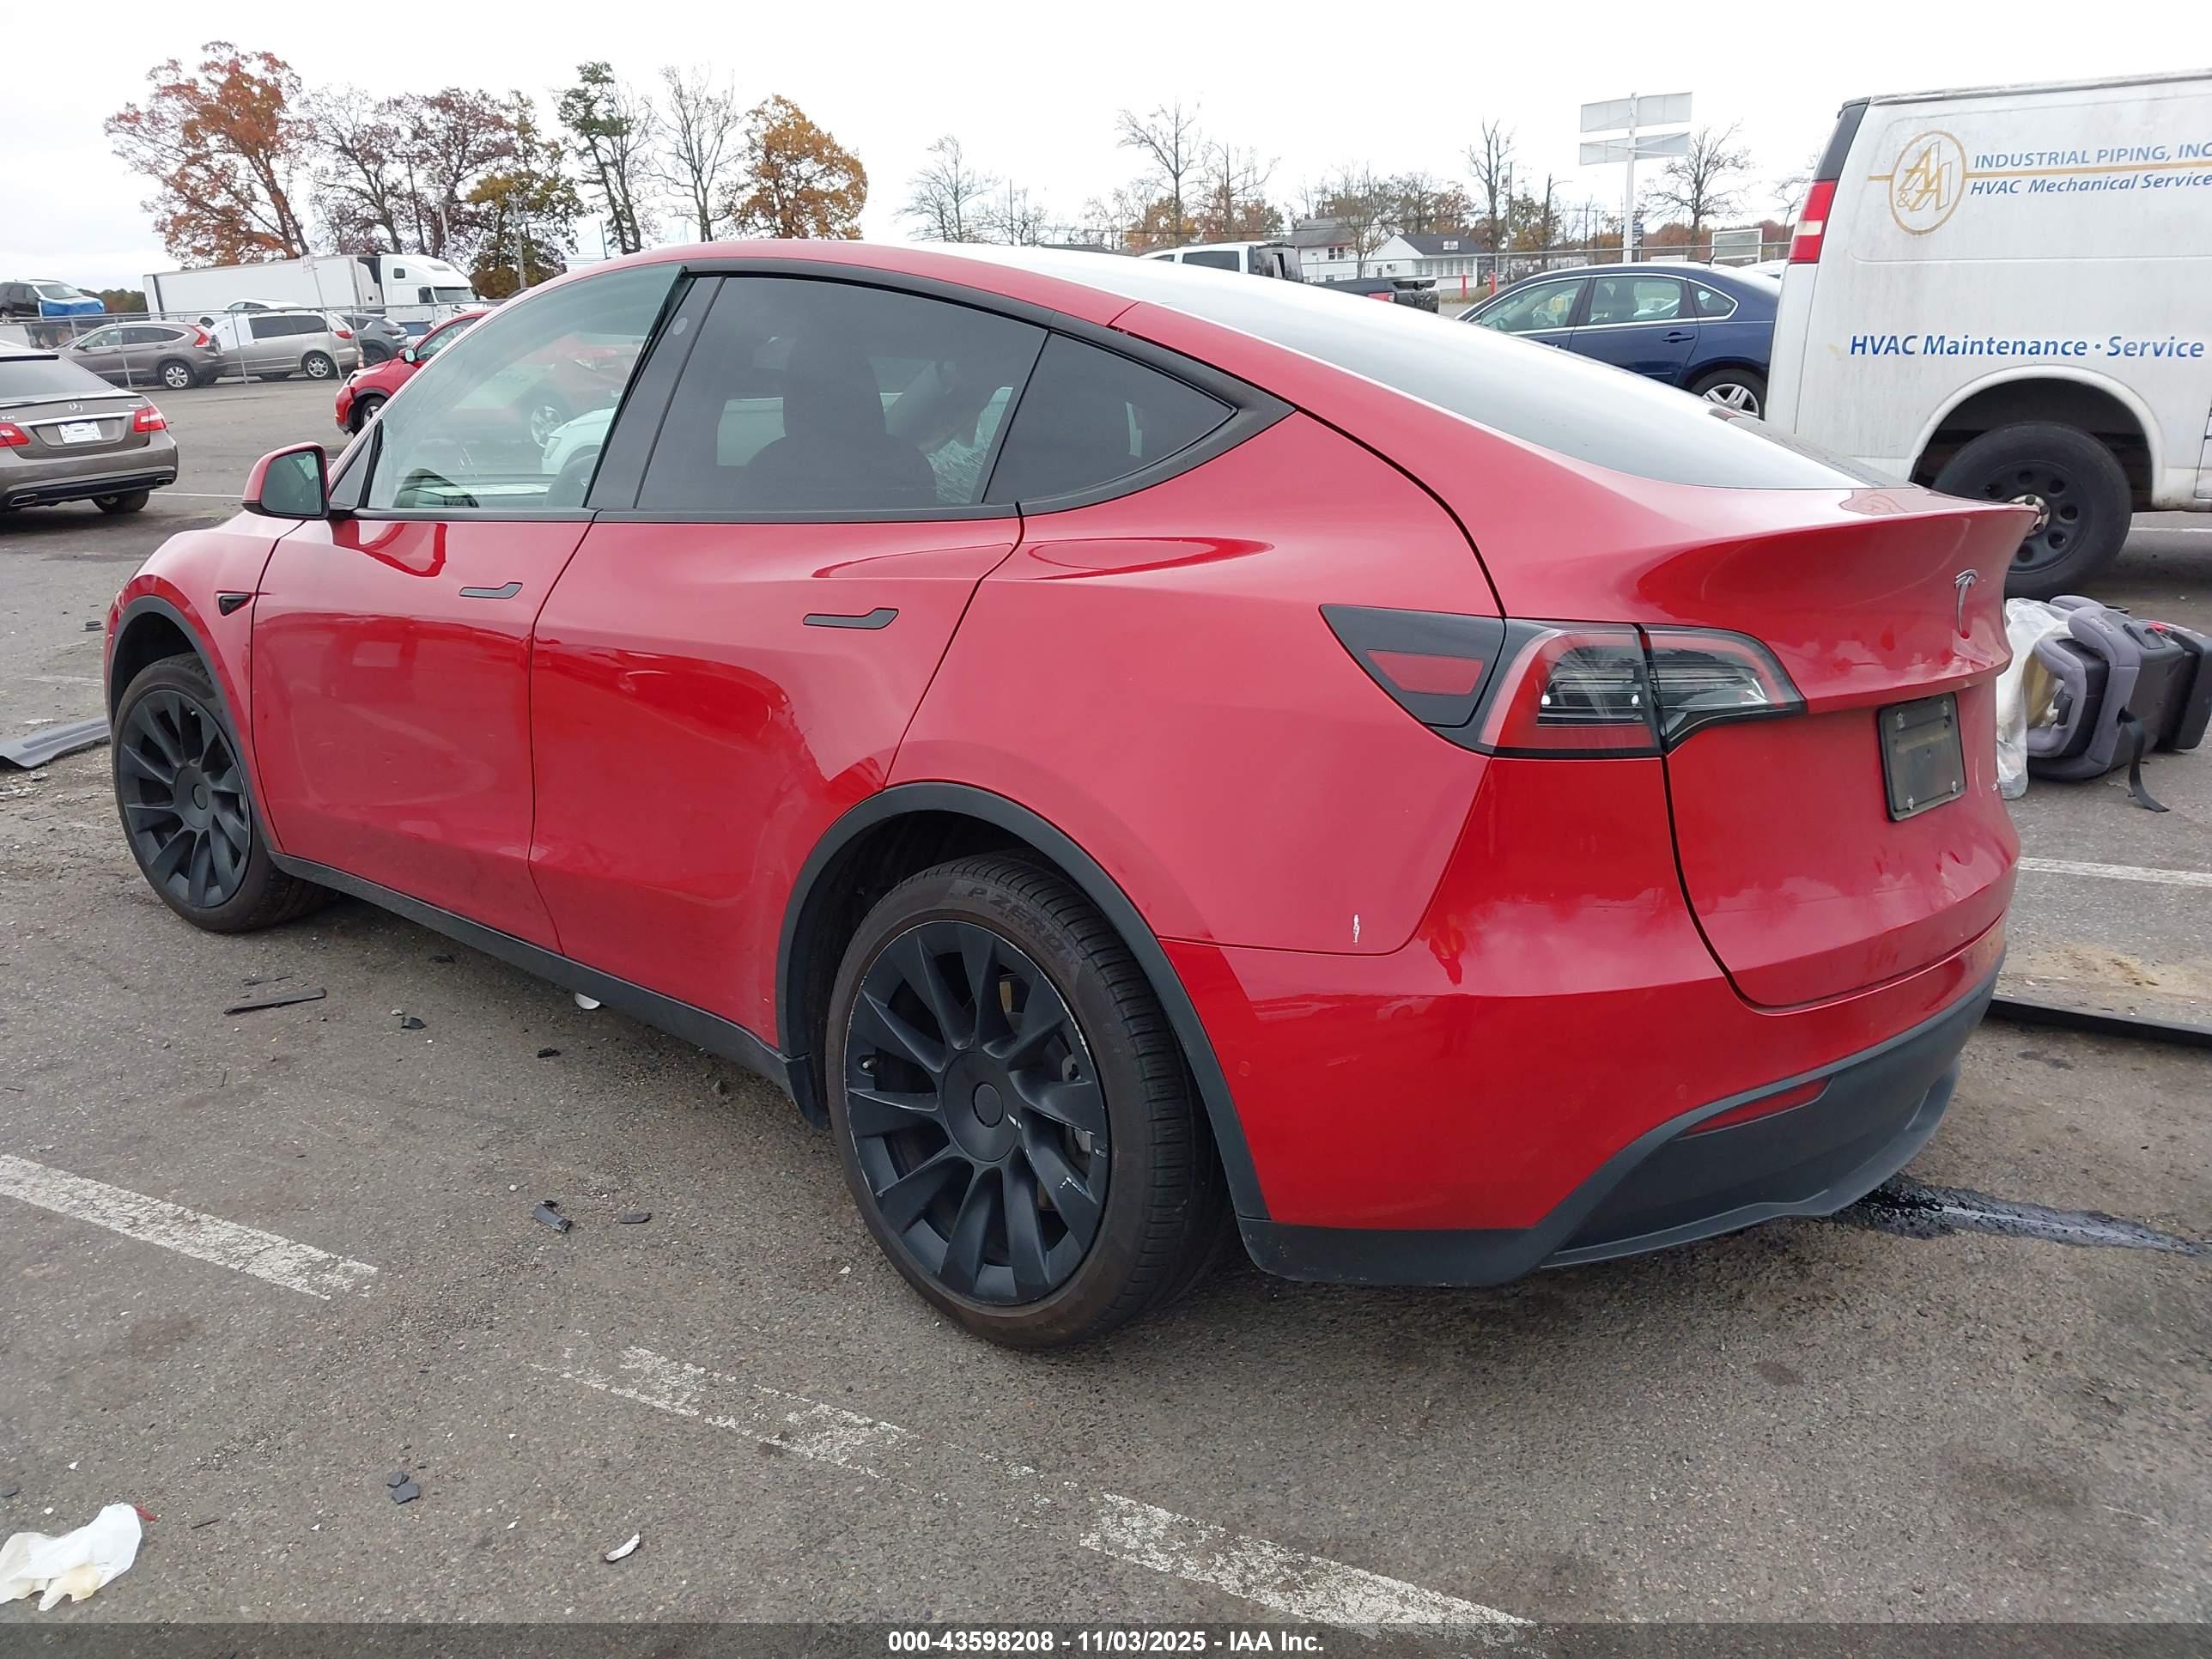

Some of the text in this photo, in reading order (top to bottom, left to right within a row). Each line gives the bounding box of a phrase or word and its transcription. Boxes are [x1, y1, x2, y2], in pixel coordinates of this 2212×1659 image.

[1974, 149, 2090, 169] INDUSTRIAL
[2096, 145, 2172, 164] PIPING,
[1970, 179, 2022, 196] HVAC
[2027, 173, 2139, 193] Mechanical
[1850, 334, 1918, 356] HVAC
[1923, 334, 2088, 356] Maintenance
[2106, 335, 2205, 358] Service
